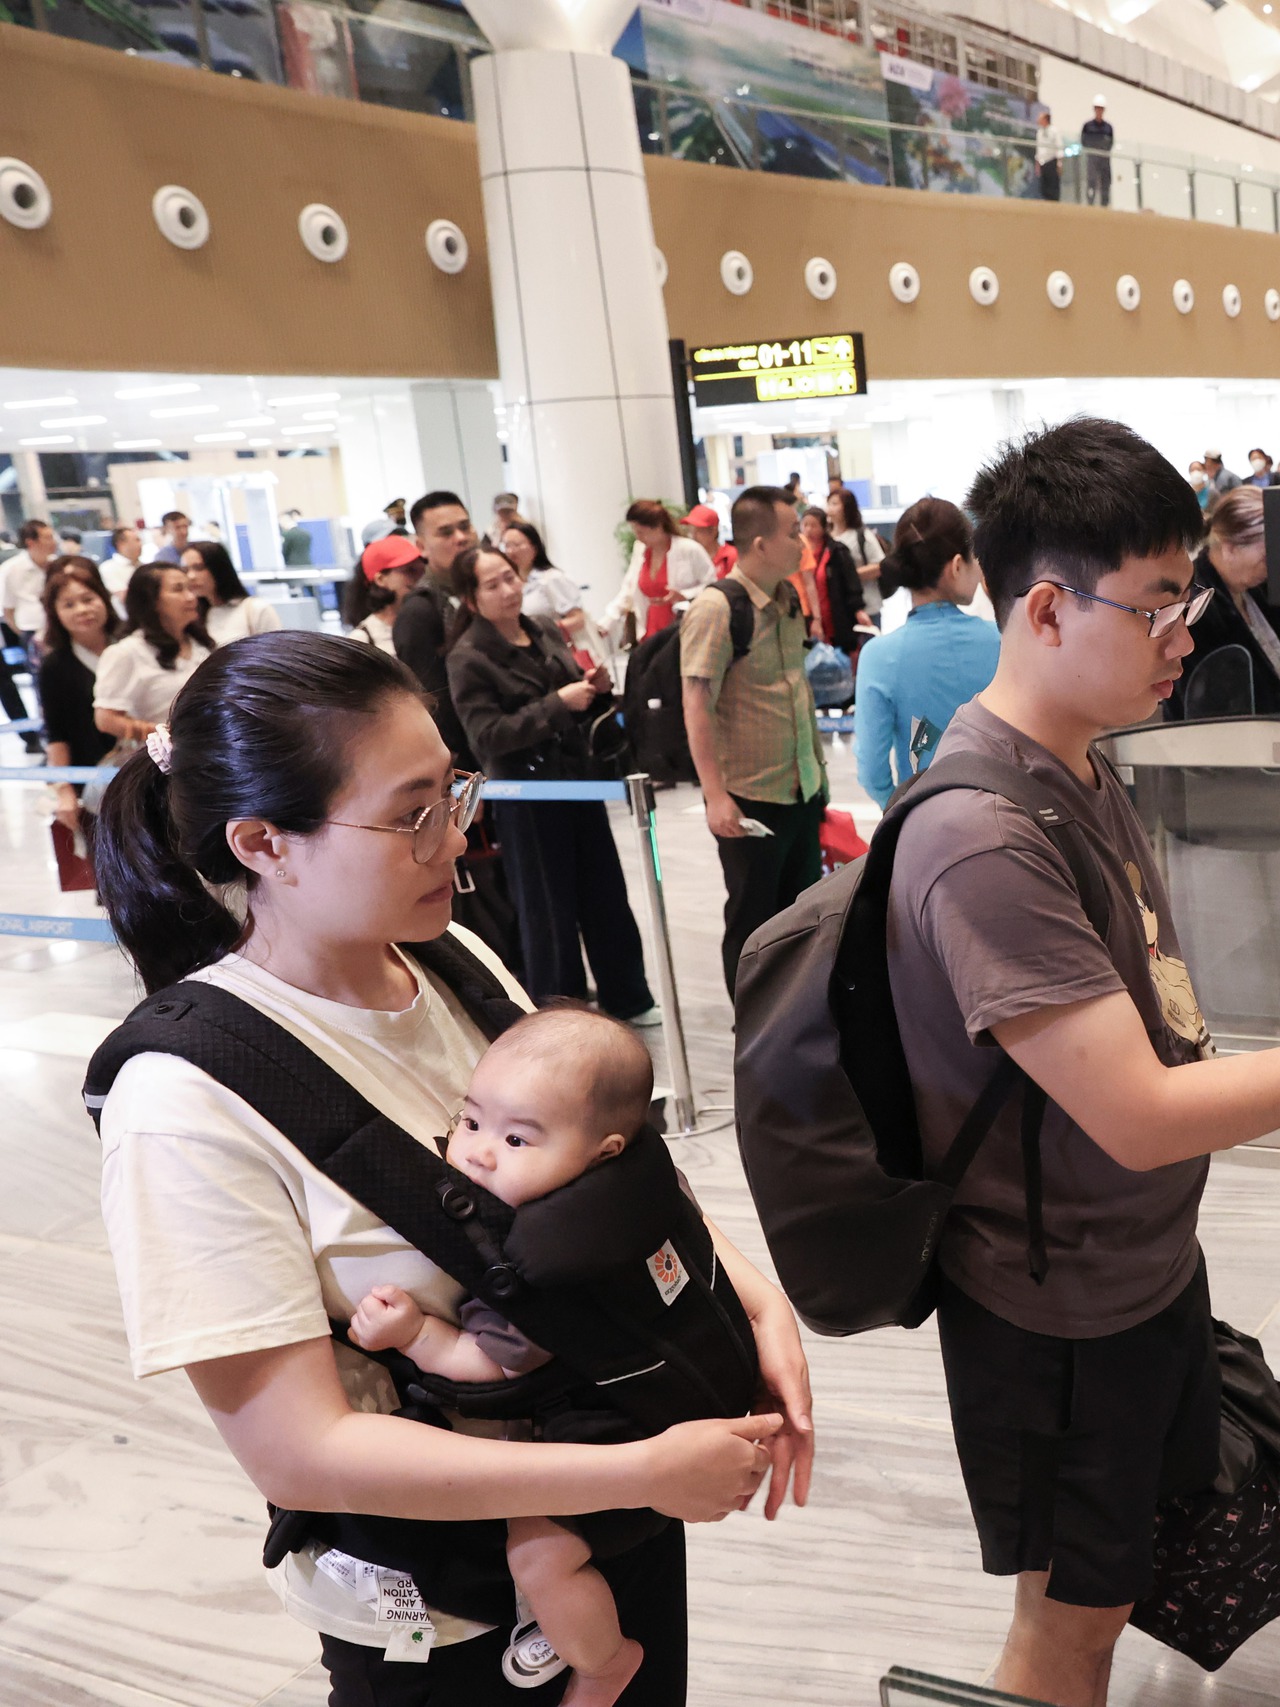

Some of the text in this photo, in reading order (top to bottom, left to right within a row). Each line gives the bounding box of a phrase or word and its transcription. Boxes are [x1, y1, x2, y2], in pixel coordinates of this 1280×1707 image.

[757, 339, 813, 369] 01-11
[29, 920, 73, 936] AIRPORT
[397, 1580, 412, 1588] RD
[395, 1598, 416, 1608] AND
